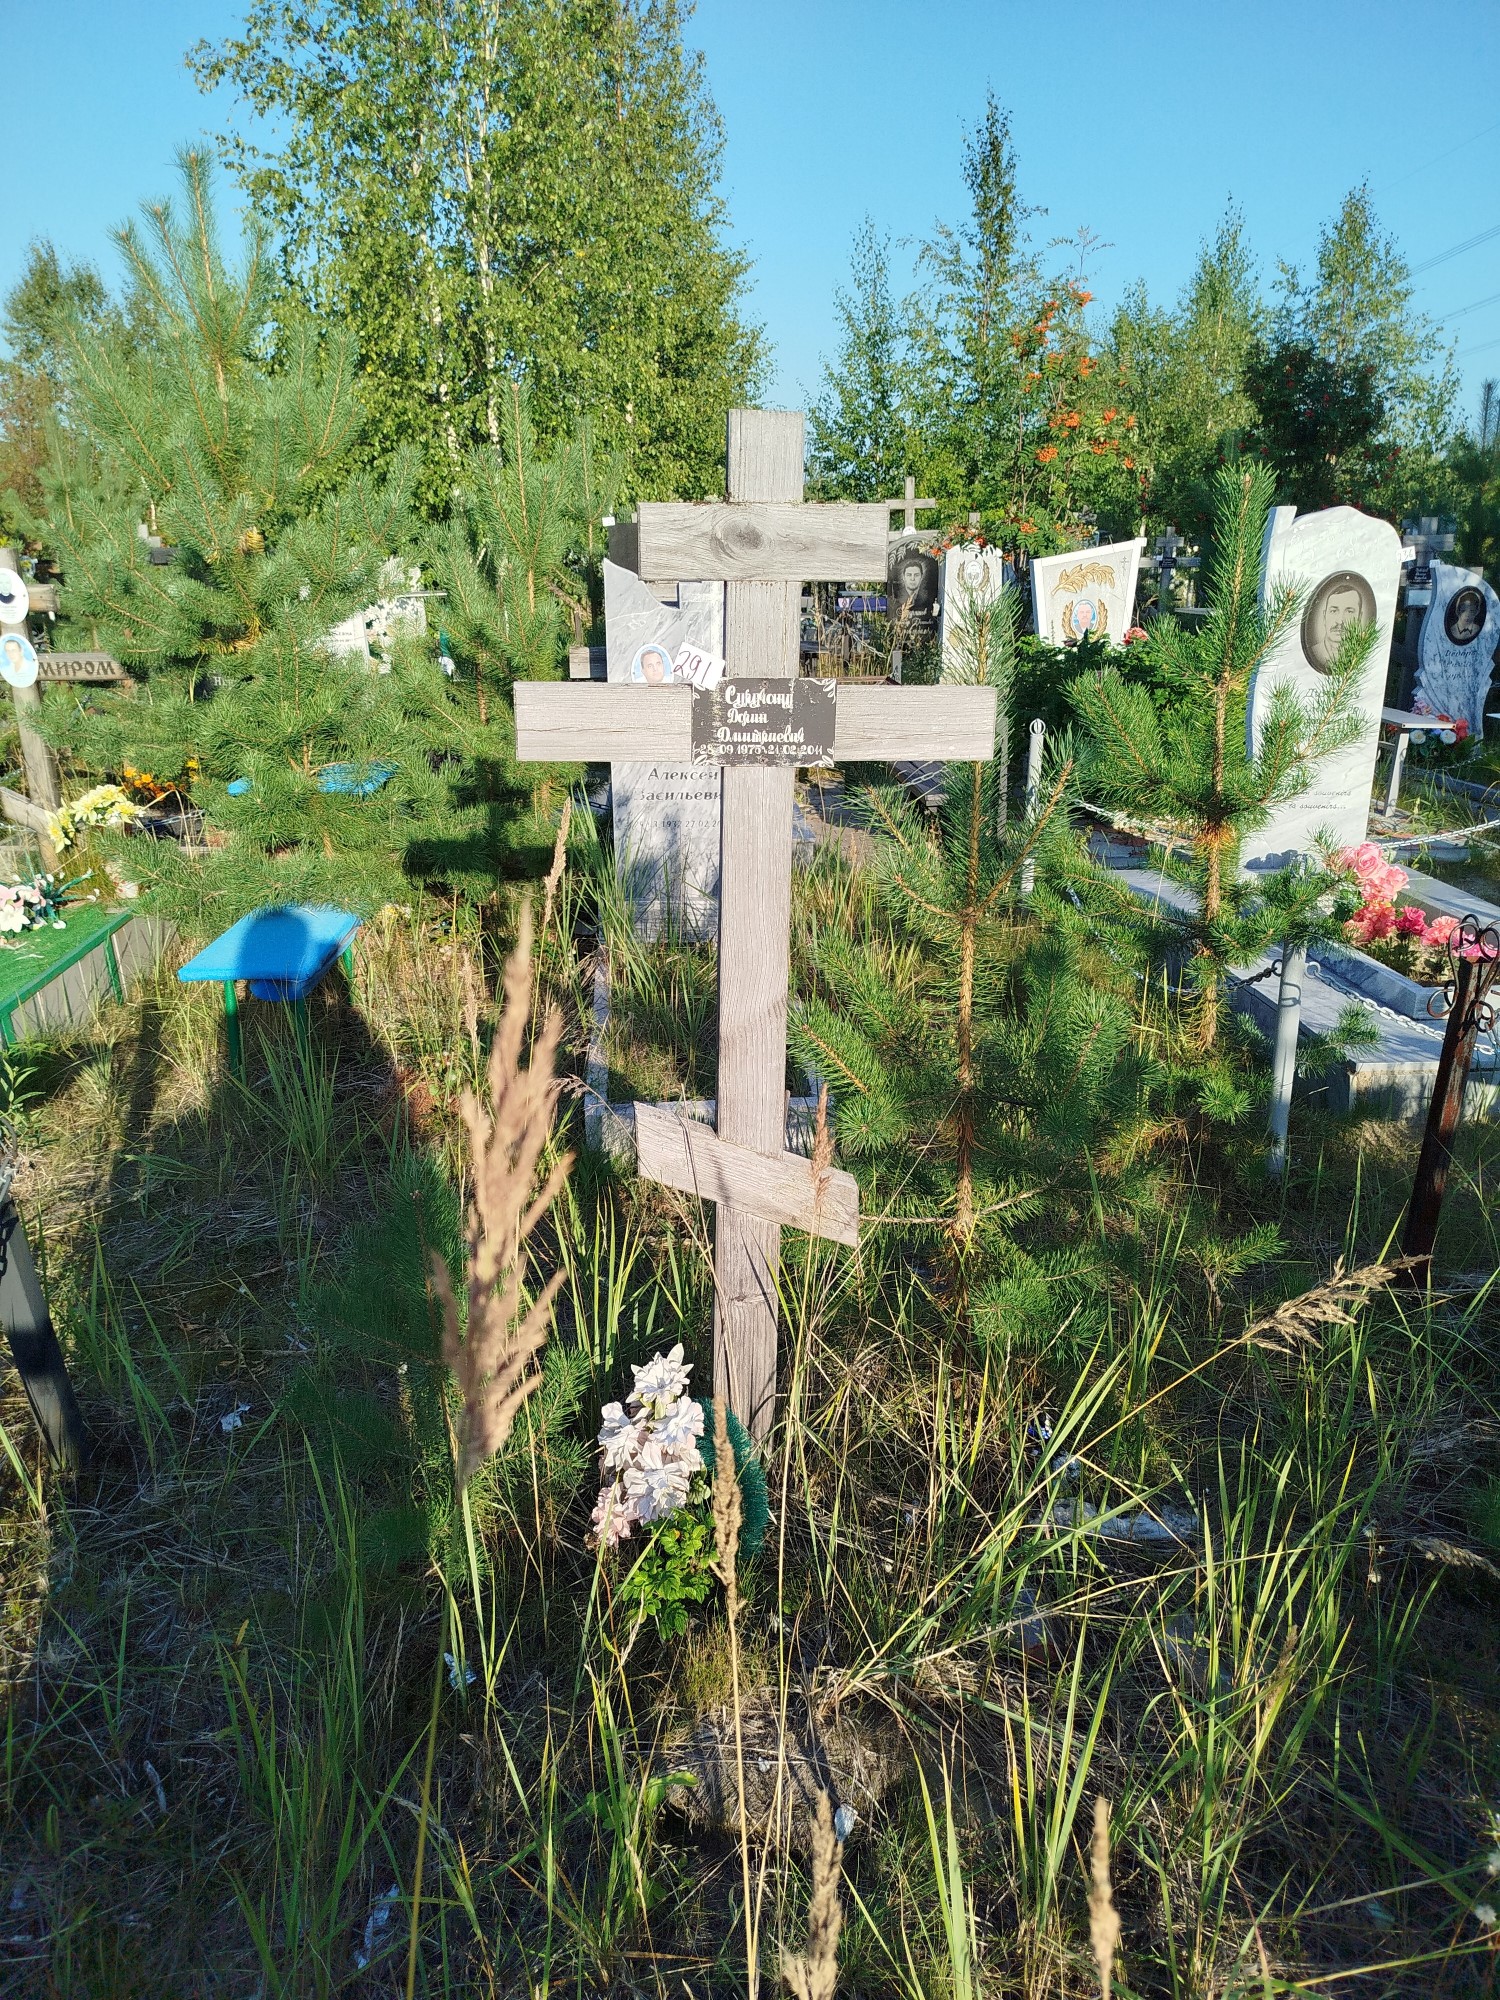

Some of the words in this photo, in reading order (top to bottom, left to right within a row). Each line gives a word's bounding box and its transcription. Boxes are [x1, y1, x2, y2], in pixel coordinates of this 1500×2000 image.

[673, 650, 713, 685] 291
[727, 708, 769, 726] Дорин
[716, 725, 805, 744] Дмитриевич
